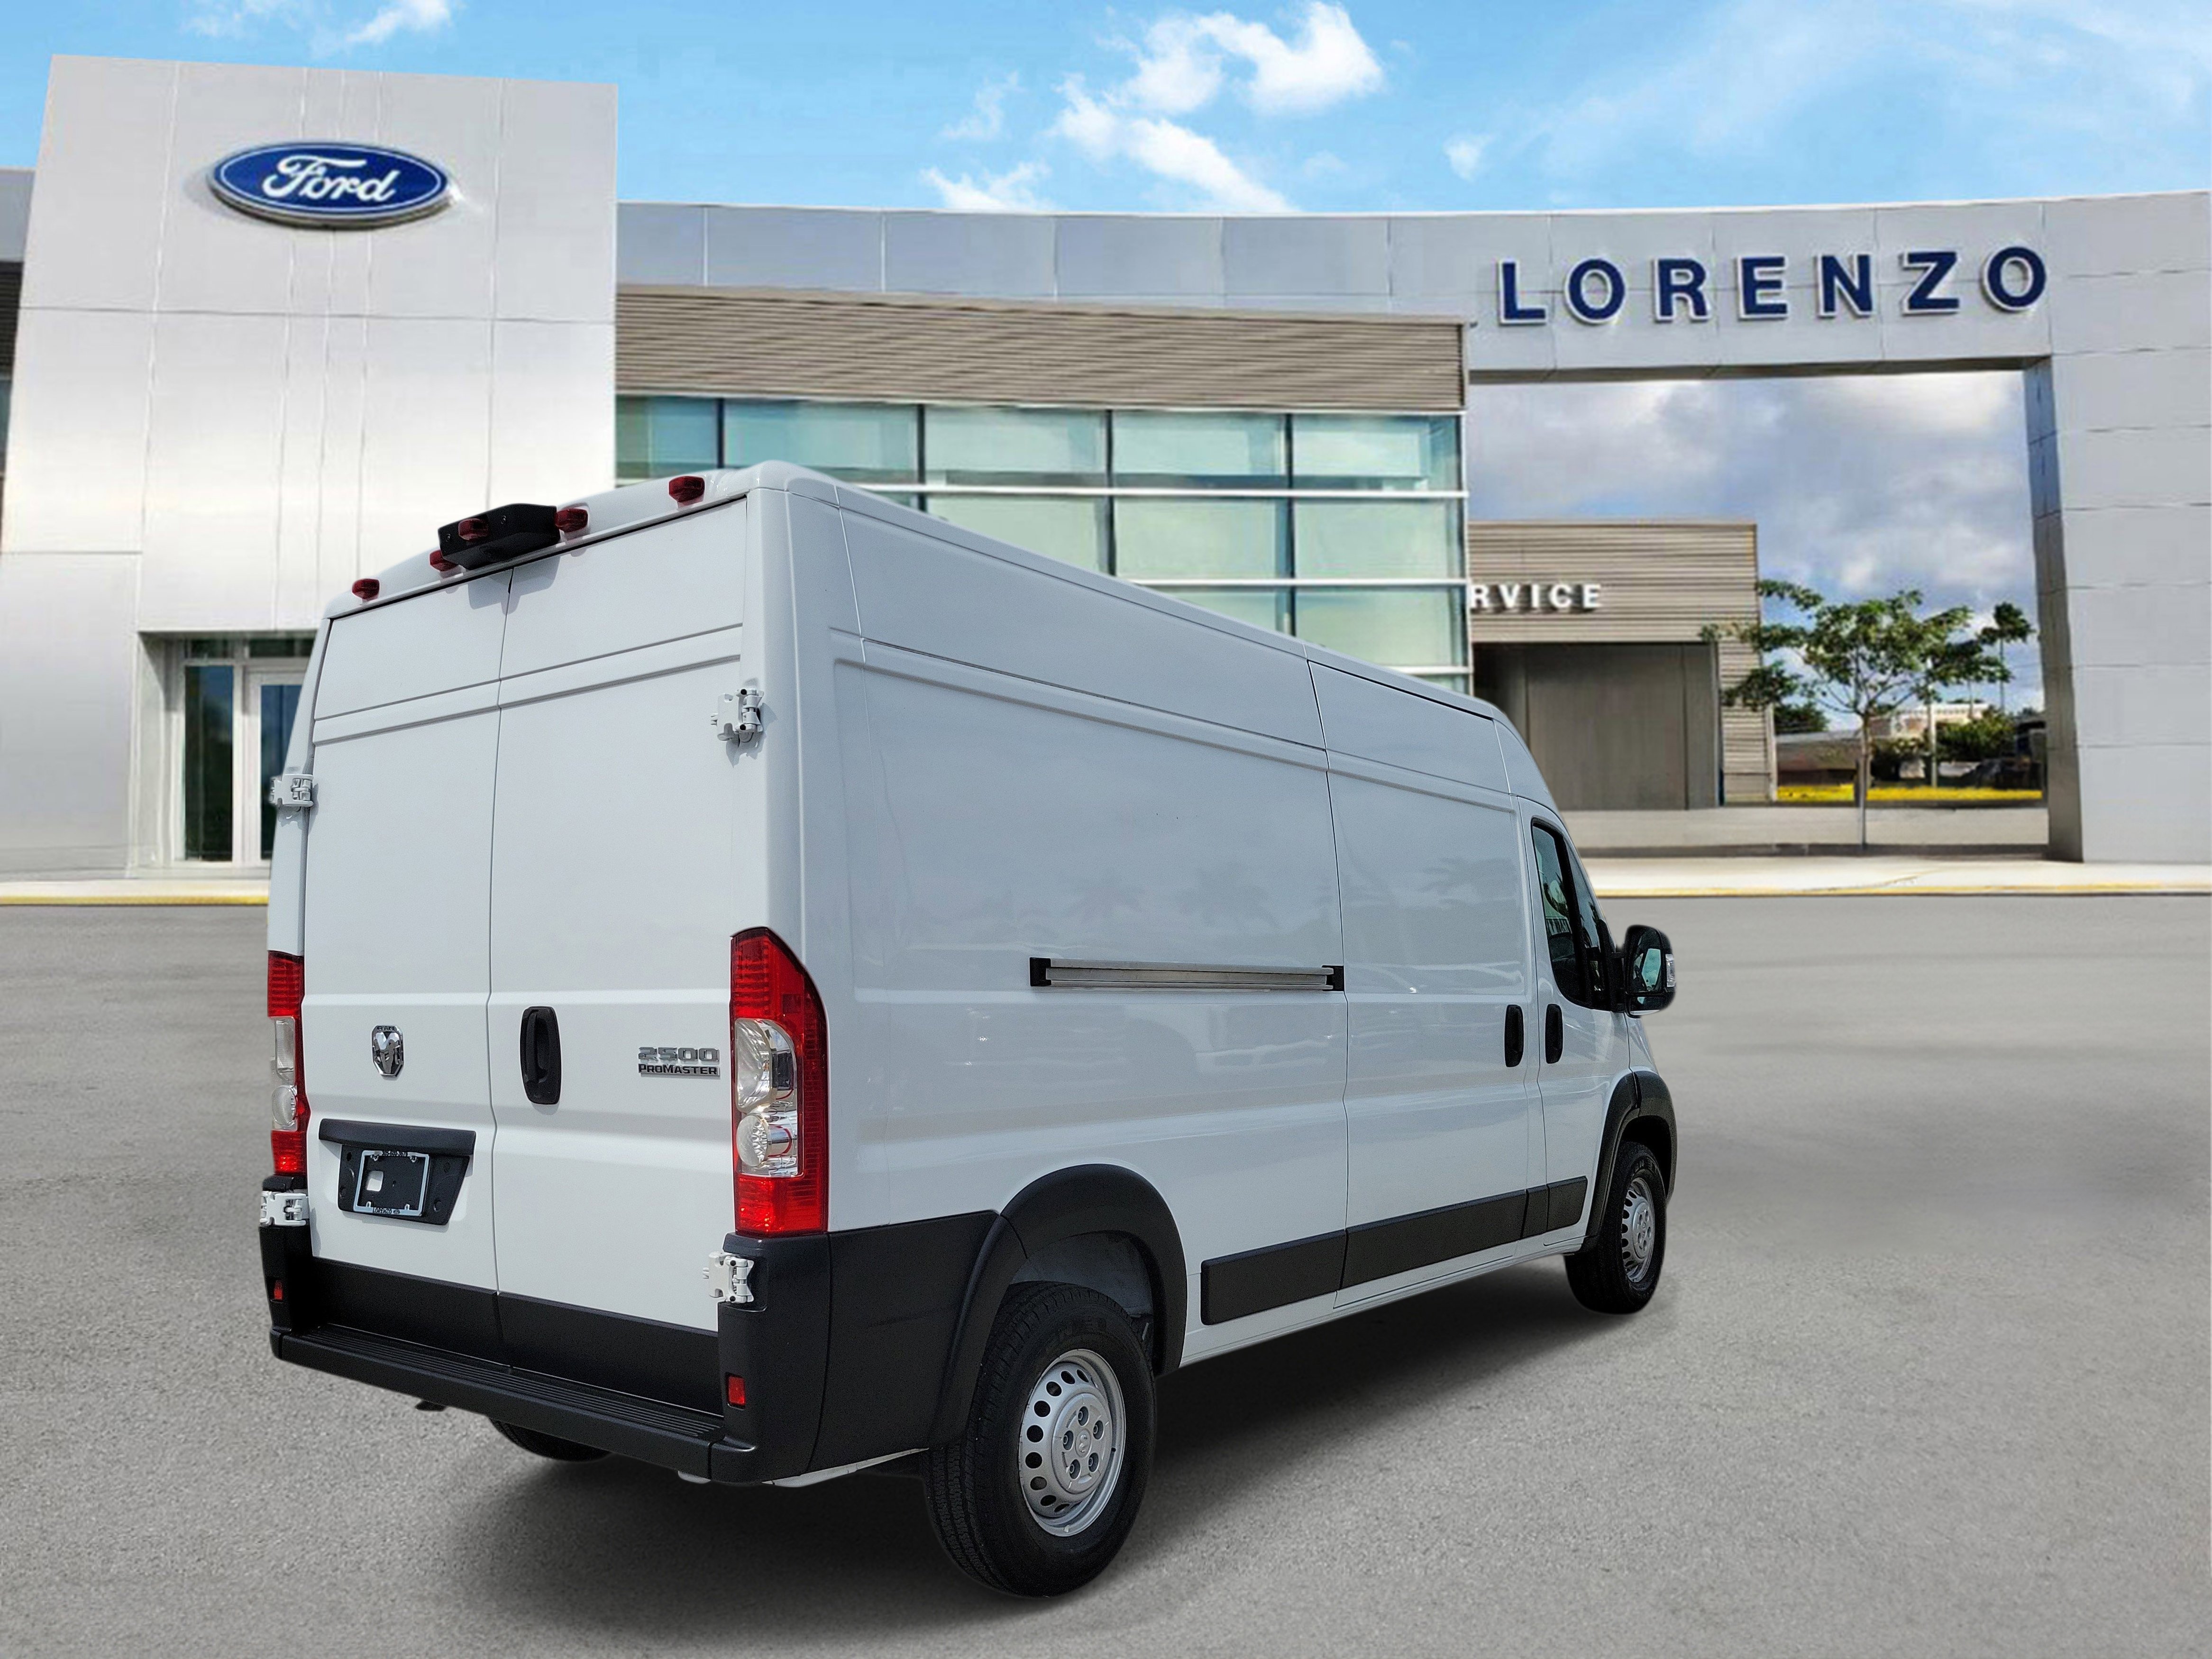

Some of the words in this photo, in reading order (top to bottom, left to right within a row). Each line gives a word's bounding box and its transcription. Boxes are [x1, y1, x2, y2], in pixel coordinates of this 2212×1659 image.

[262, 154, 400, 201] Ford
[1498, 246, 2047, 324] LORENZO
[638, 1047, 720, 1063] 2500
